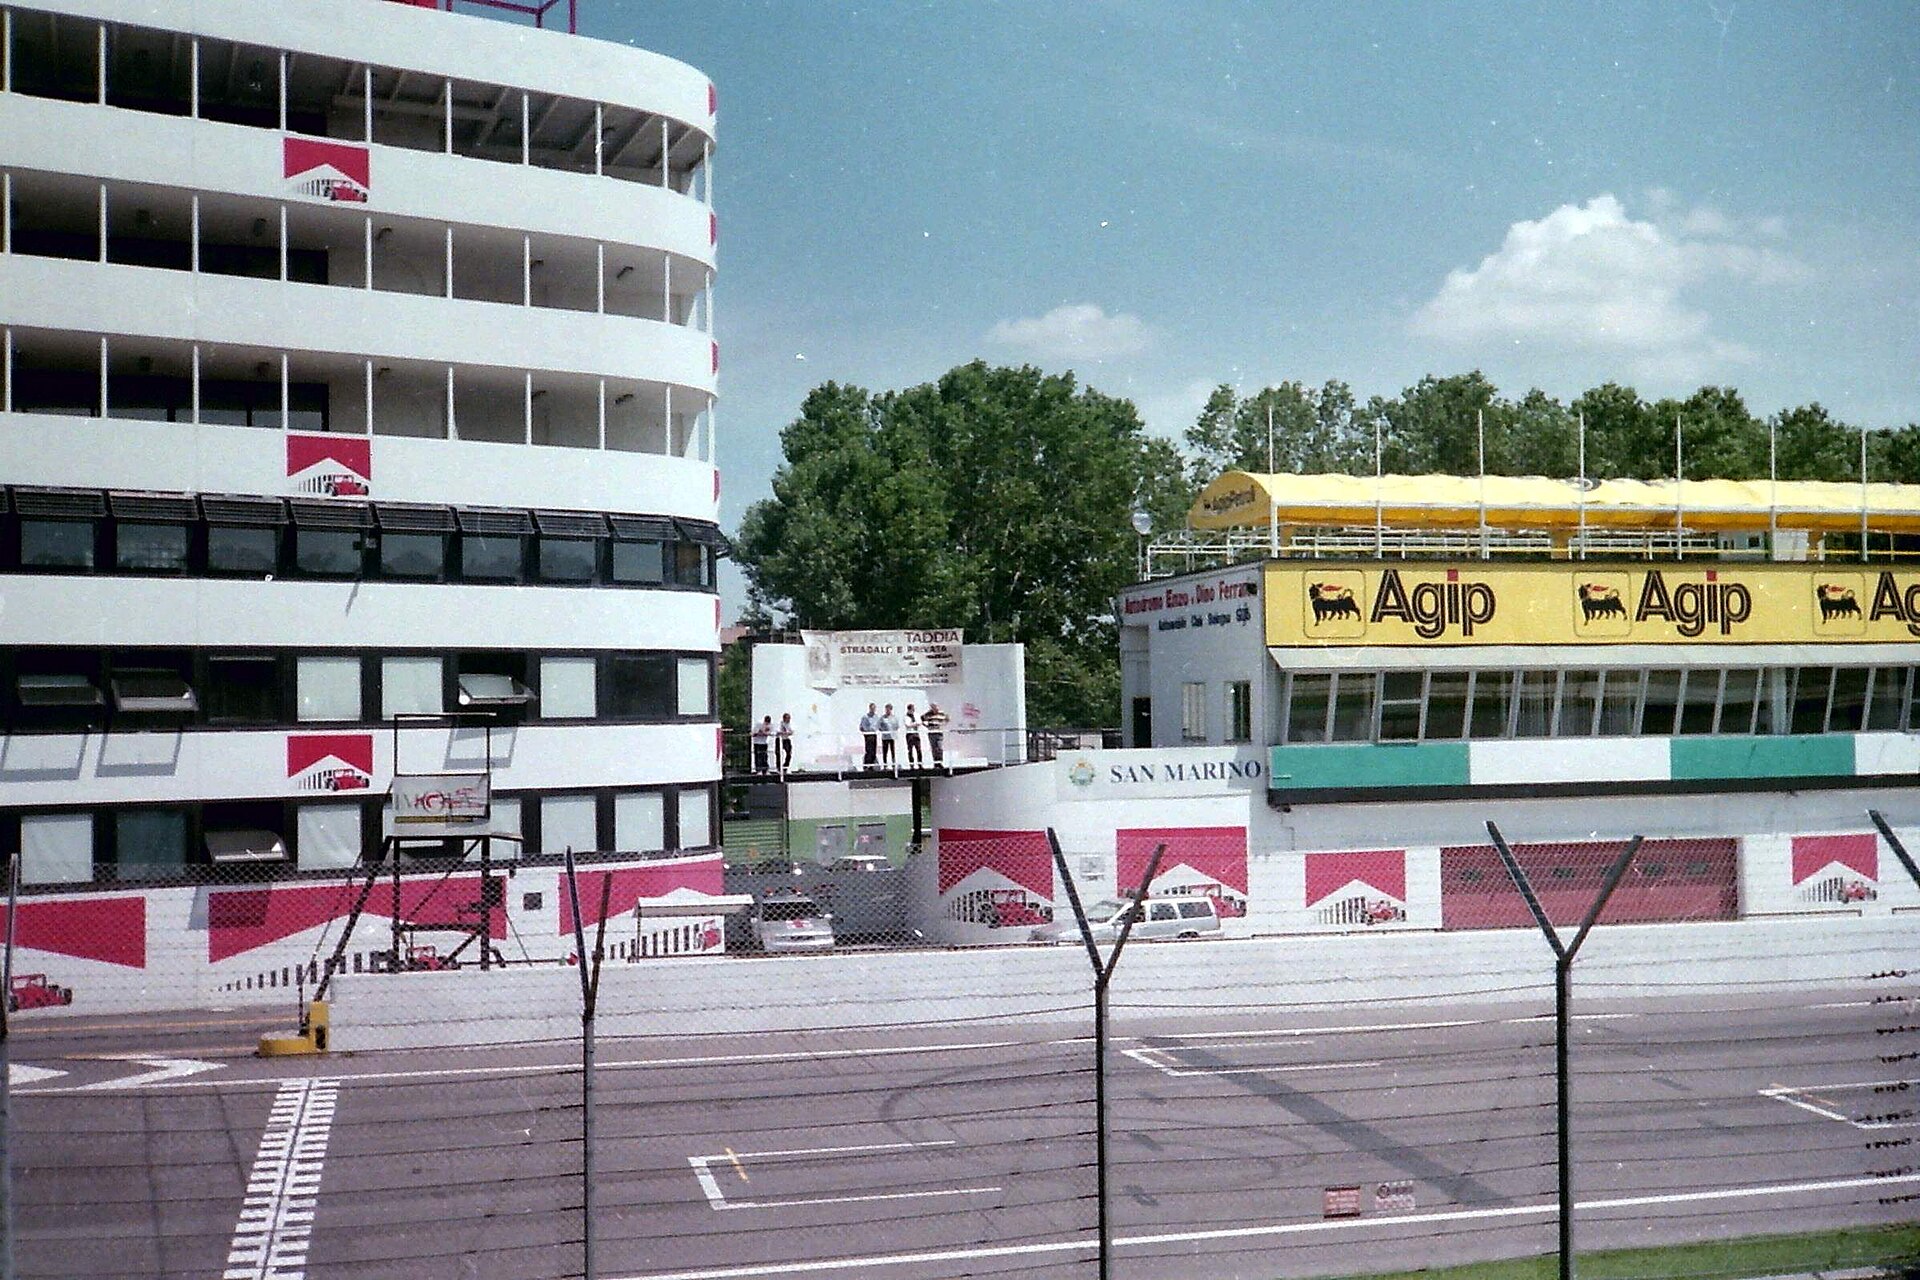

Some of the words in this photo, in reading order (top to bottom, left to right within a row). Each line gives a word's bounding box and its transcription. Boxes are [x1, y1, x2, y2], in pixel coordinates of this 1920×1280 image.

[1370, 569, 1496, 639] Agip
[1635, 569, 1752, 638] Agip
[904, 631, 959, 643] TADDIA
[1110, 764, 1154, 784] SAN
[1164, 759, 1261, 782] MARINO
